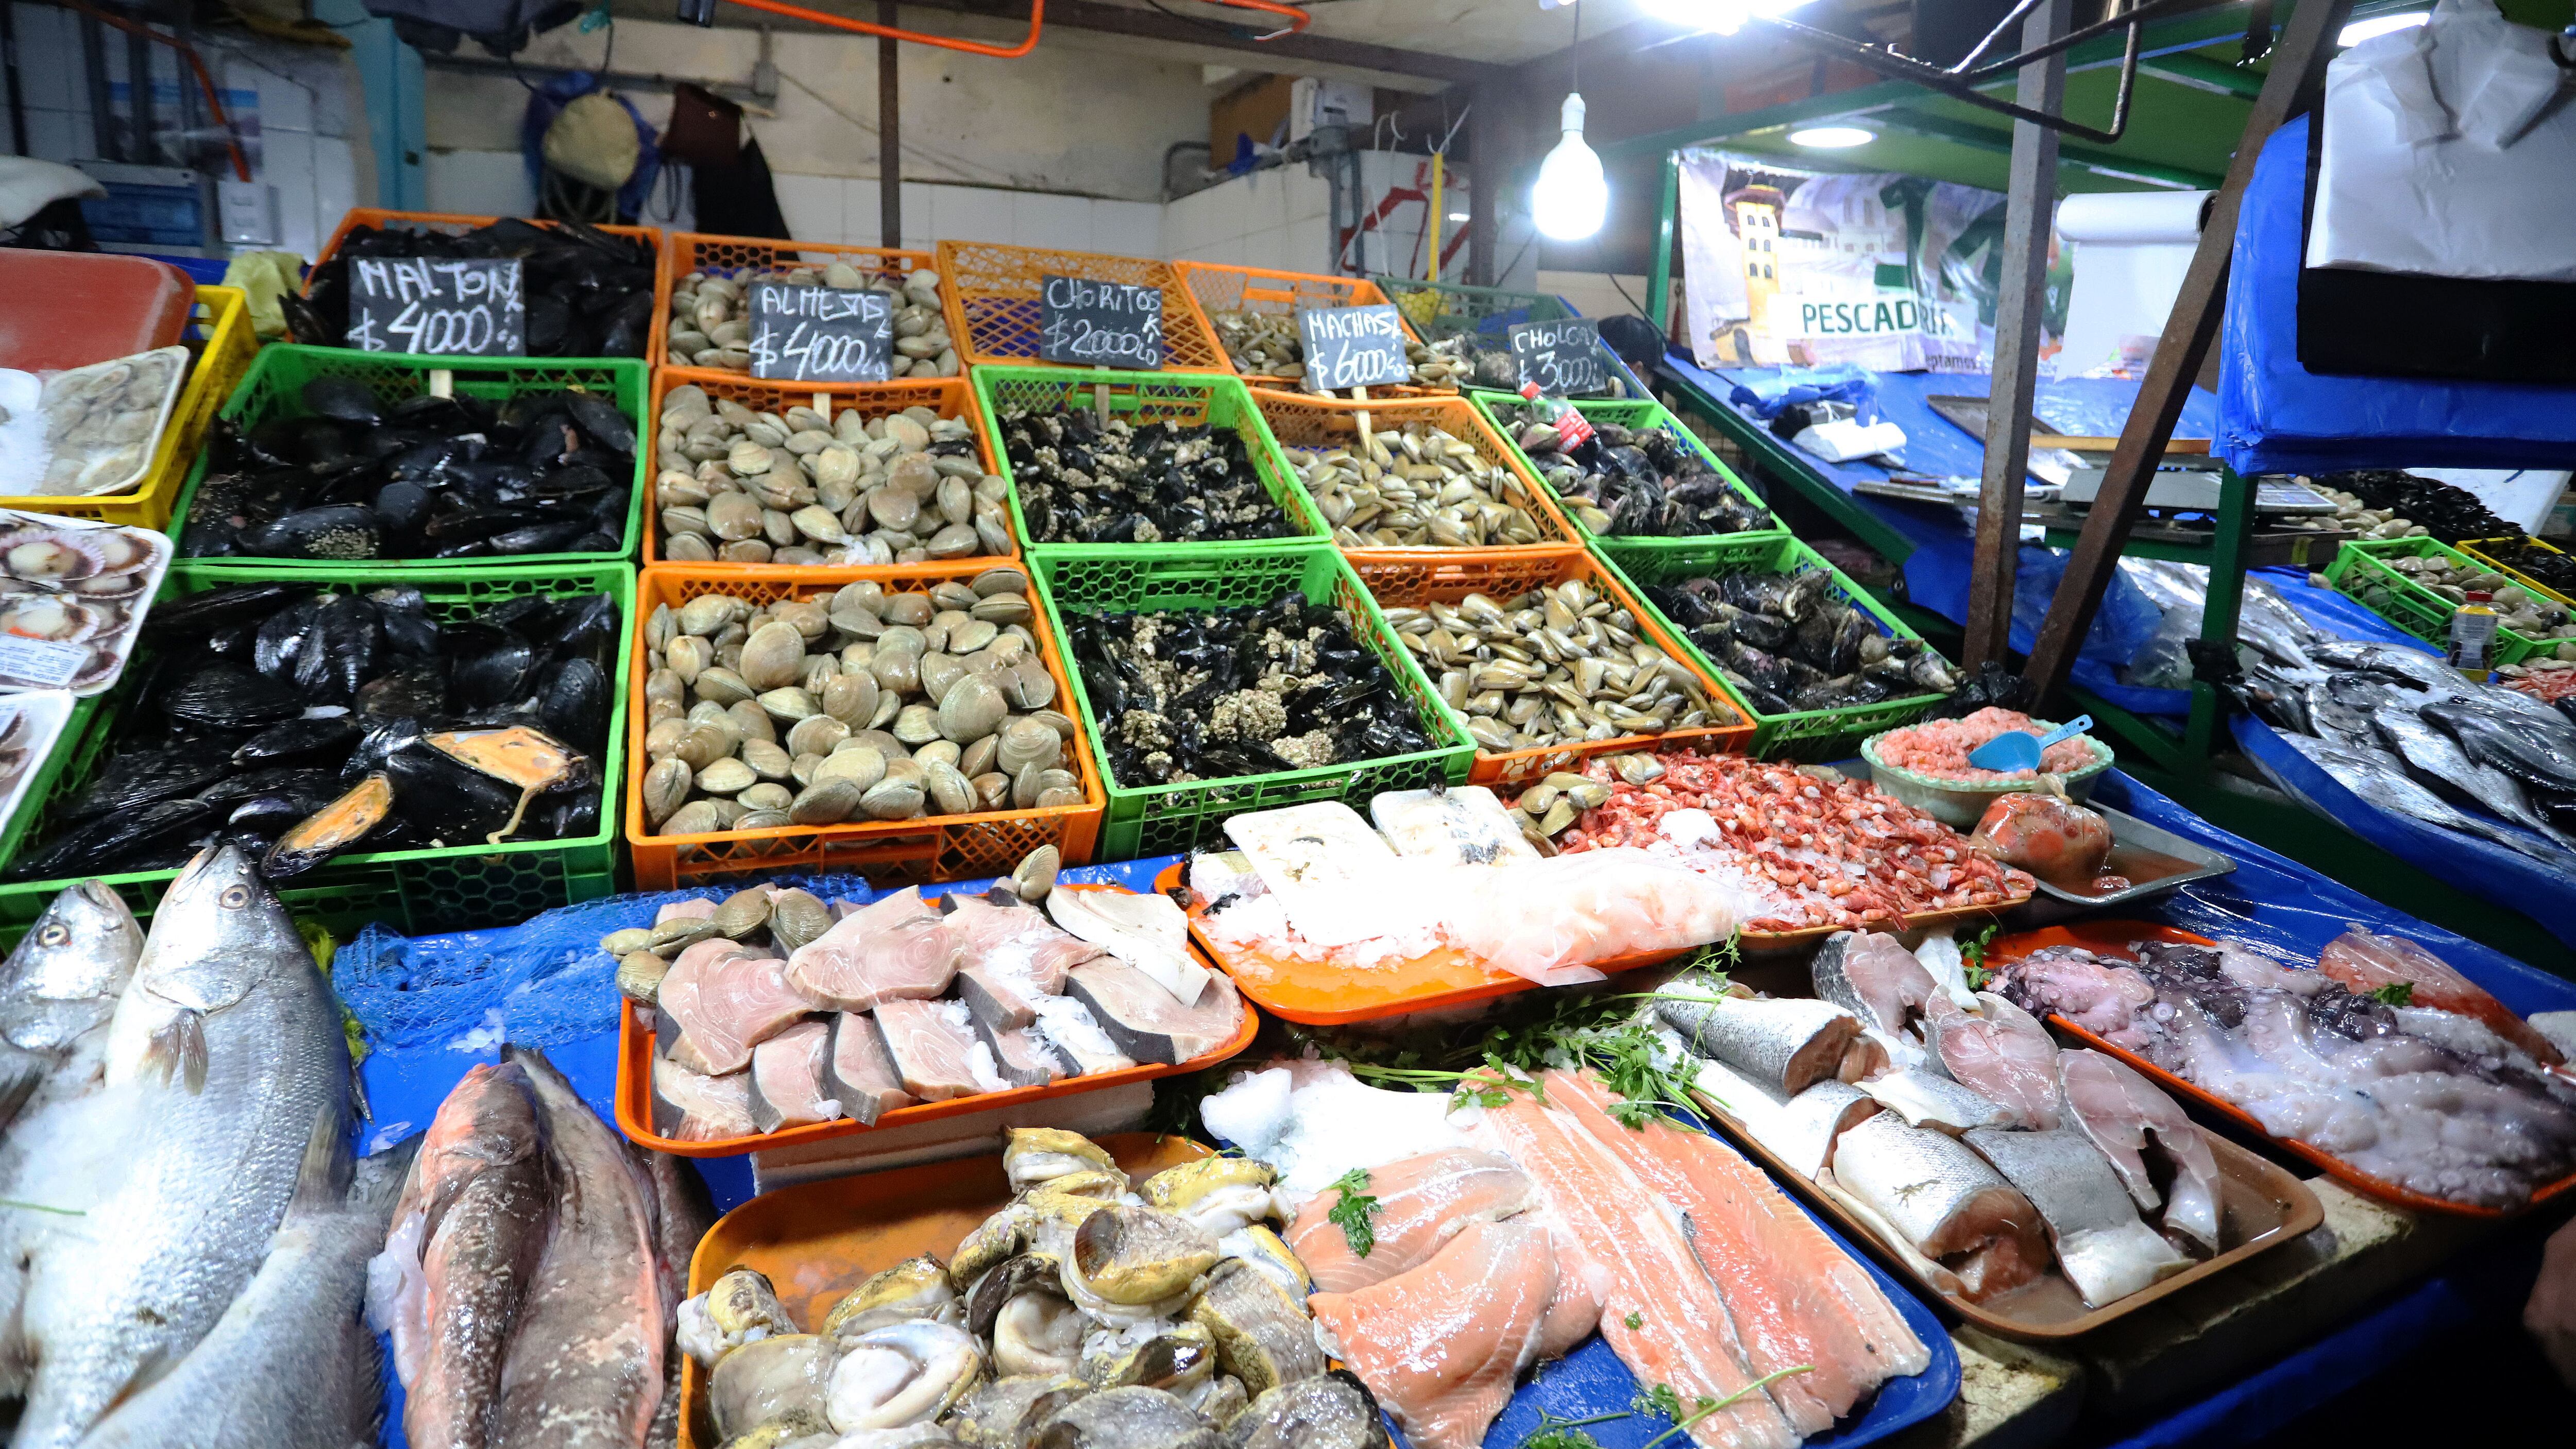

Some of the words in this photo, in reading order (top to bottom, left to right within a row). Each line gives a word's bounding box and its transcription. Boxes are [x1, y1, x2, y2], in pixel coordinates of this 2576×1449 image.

[358, 257, 520, 303] MALTON
[762, 286, 884, 323] ALMEJAS
[1308, 311, 1393, 342] MACHAS
